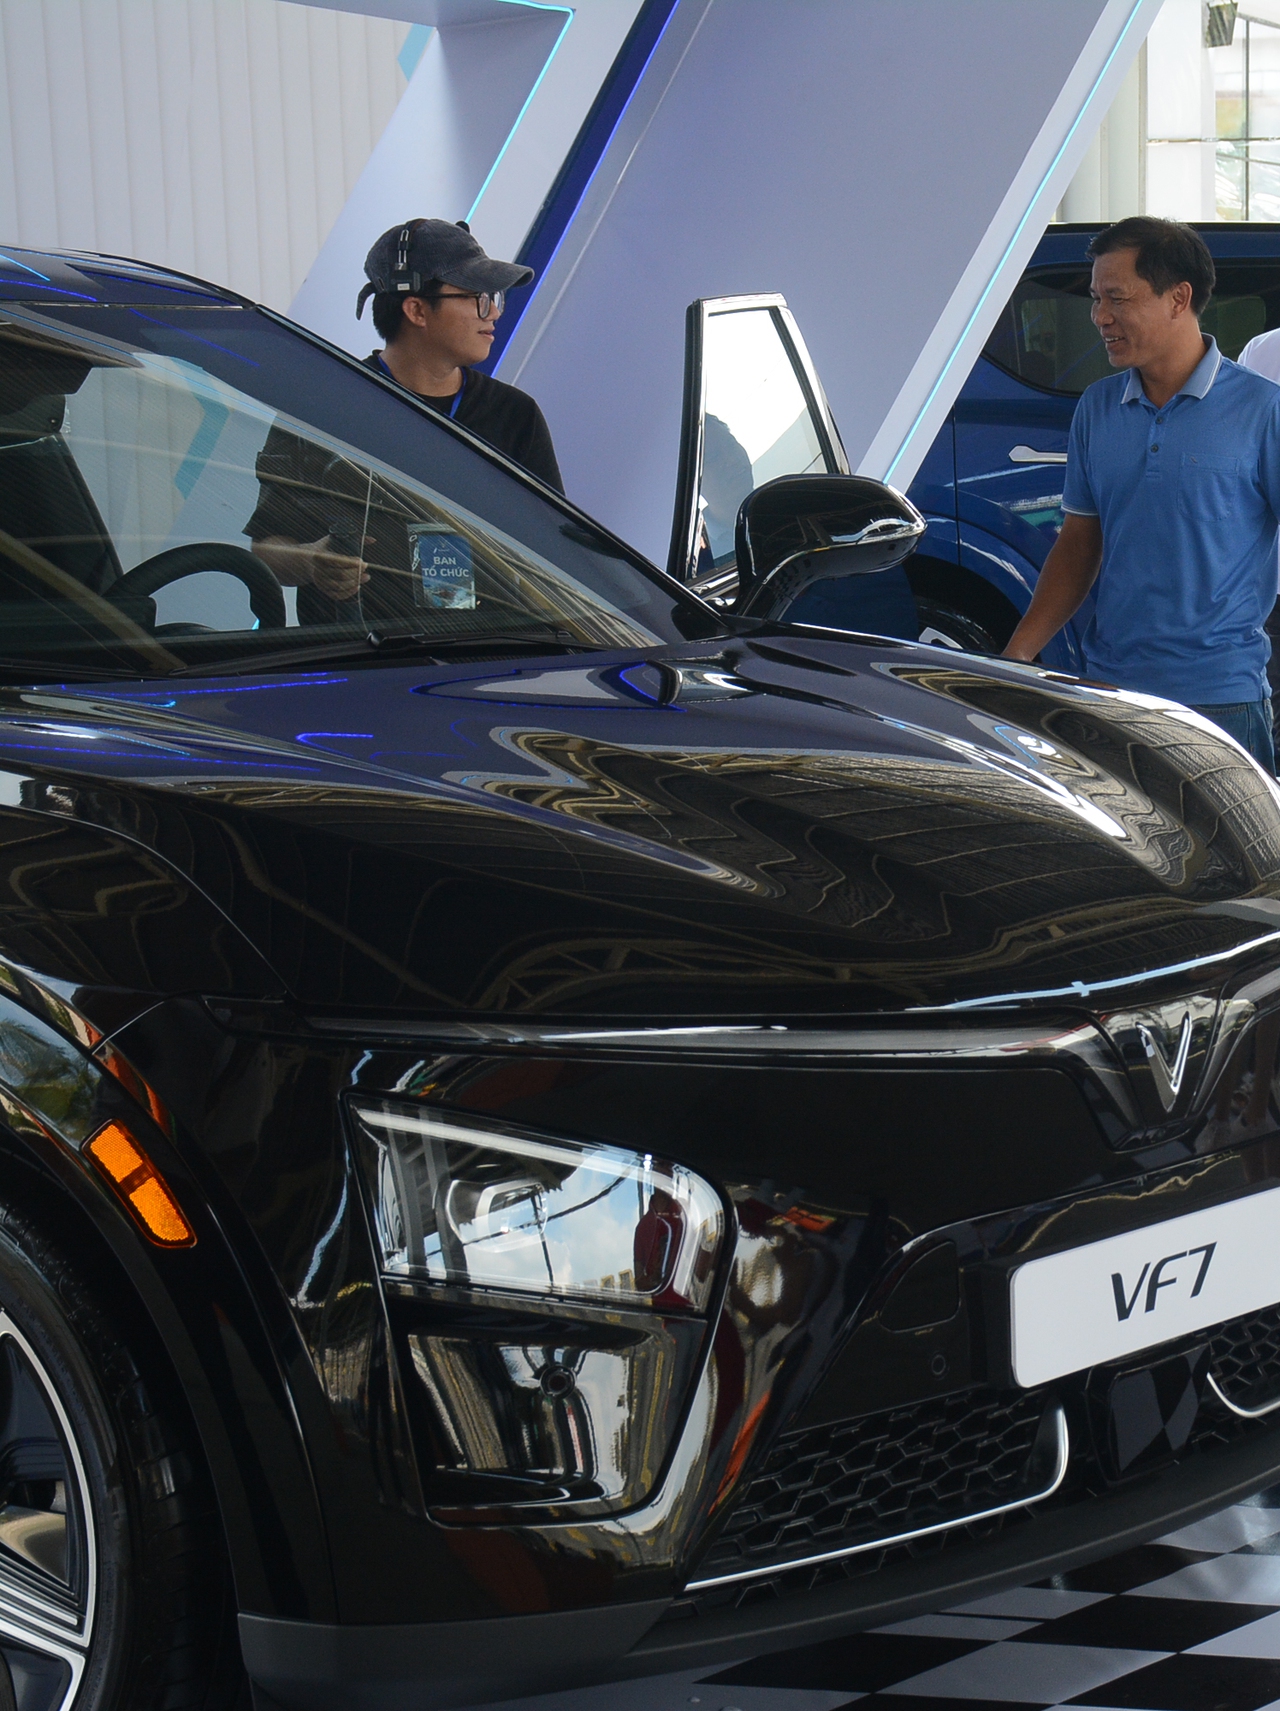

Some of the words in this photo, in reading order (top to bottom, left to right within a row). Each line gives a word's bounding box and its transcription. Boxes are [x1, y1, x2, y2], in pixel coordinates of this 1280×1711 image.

[433, 556, 457, 566] BAN
[440, 566, 470, 577] CHỨC
[1110, 1240, 1218, 1322] VF7
